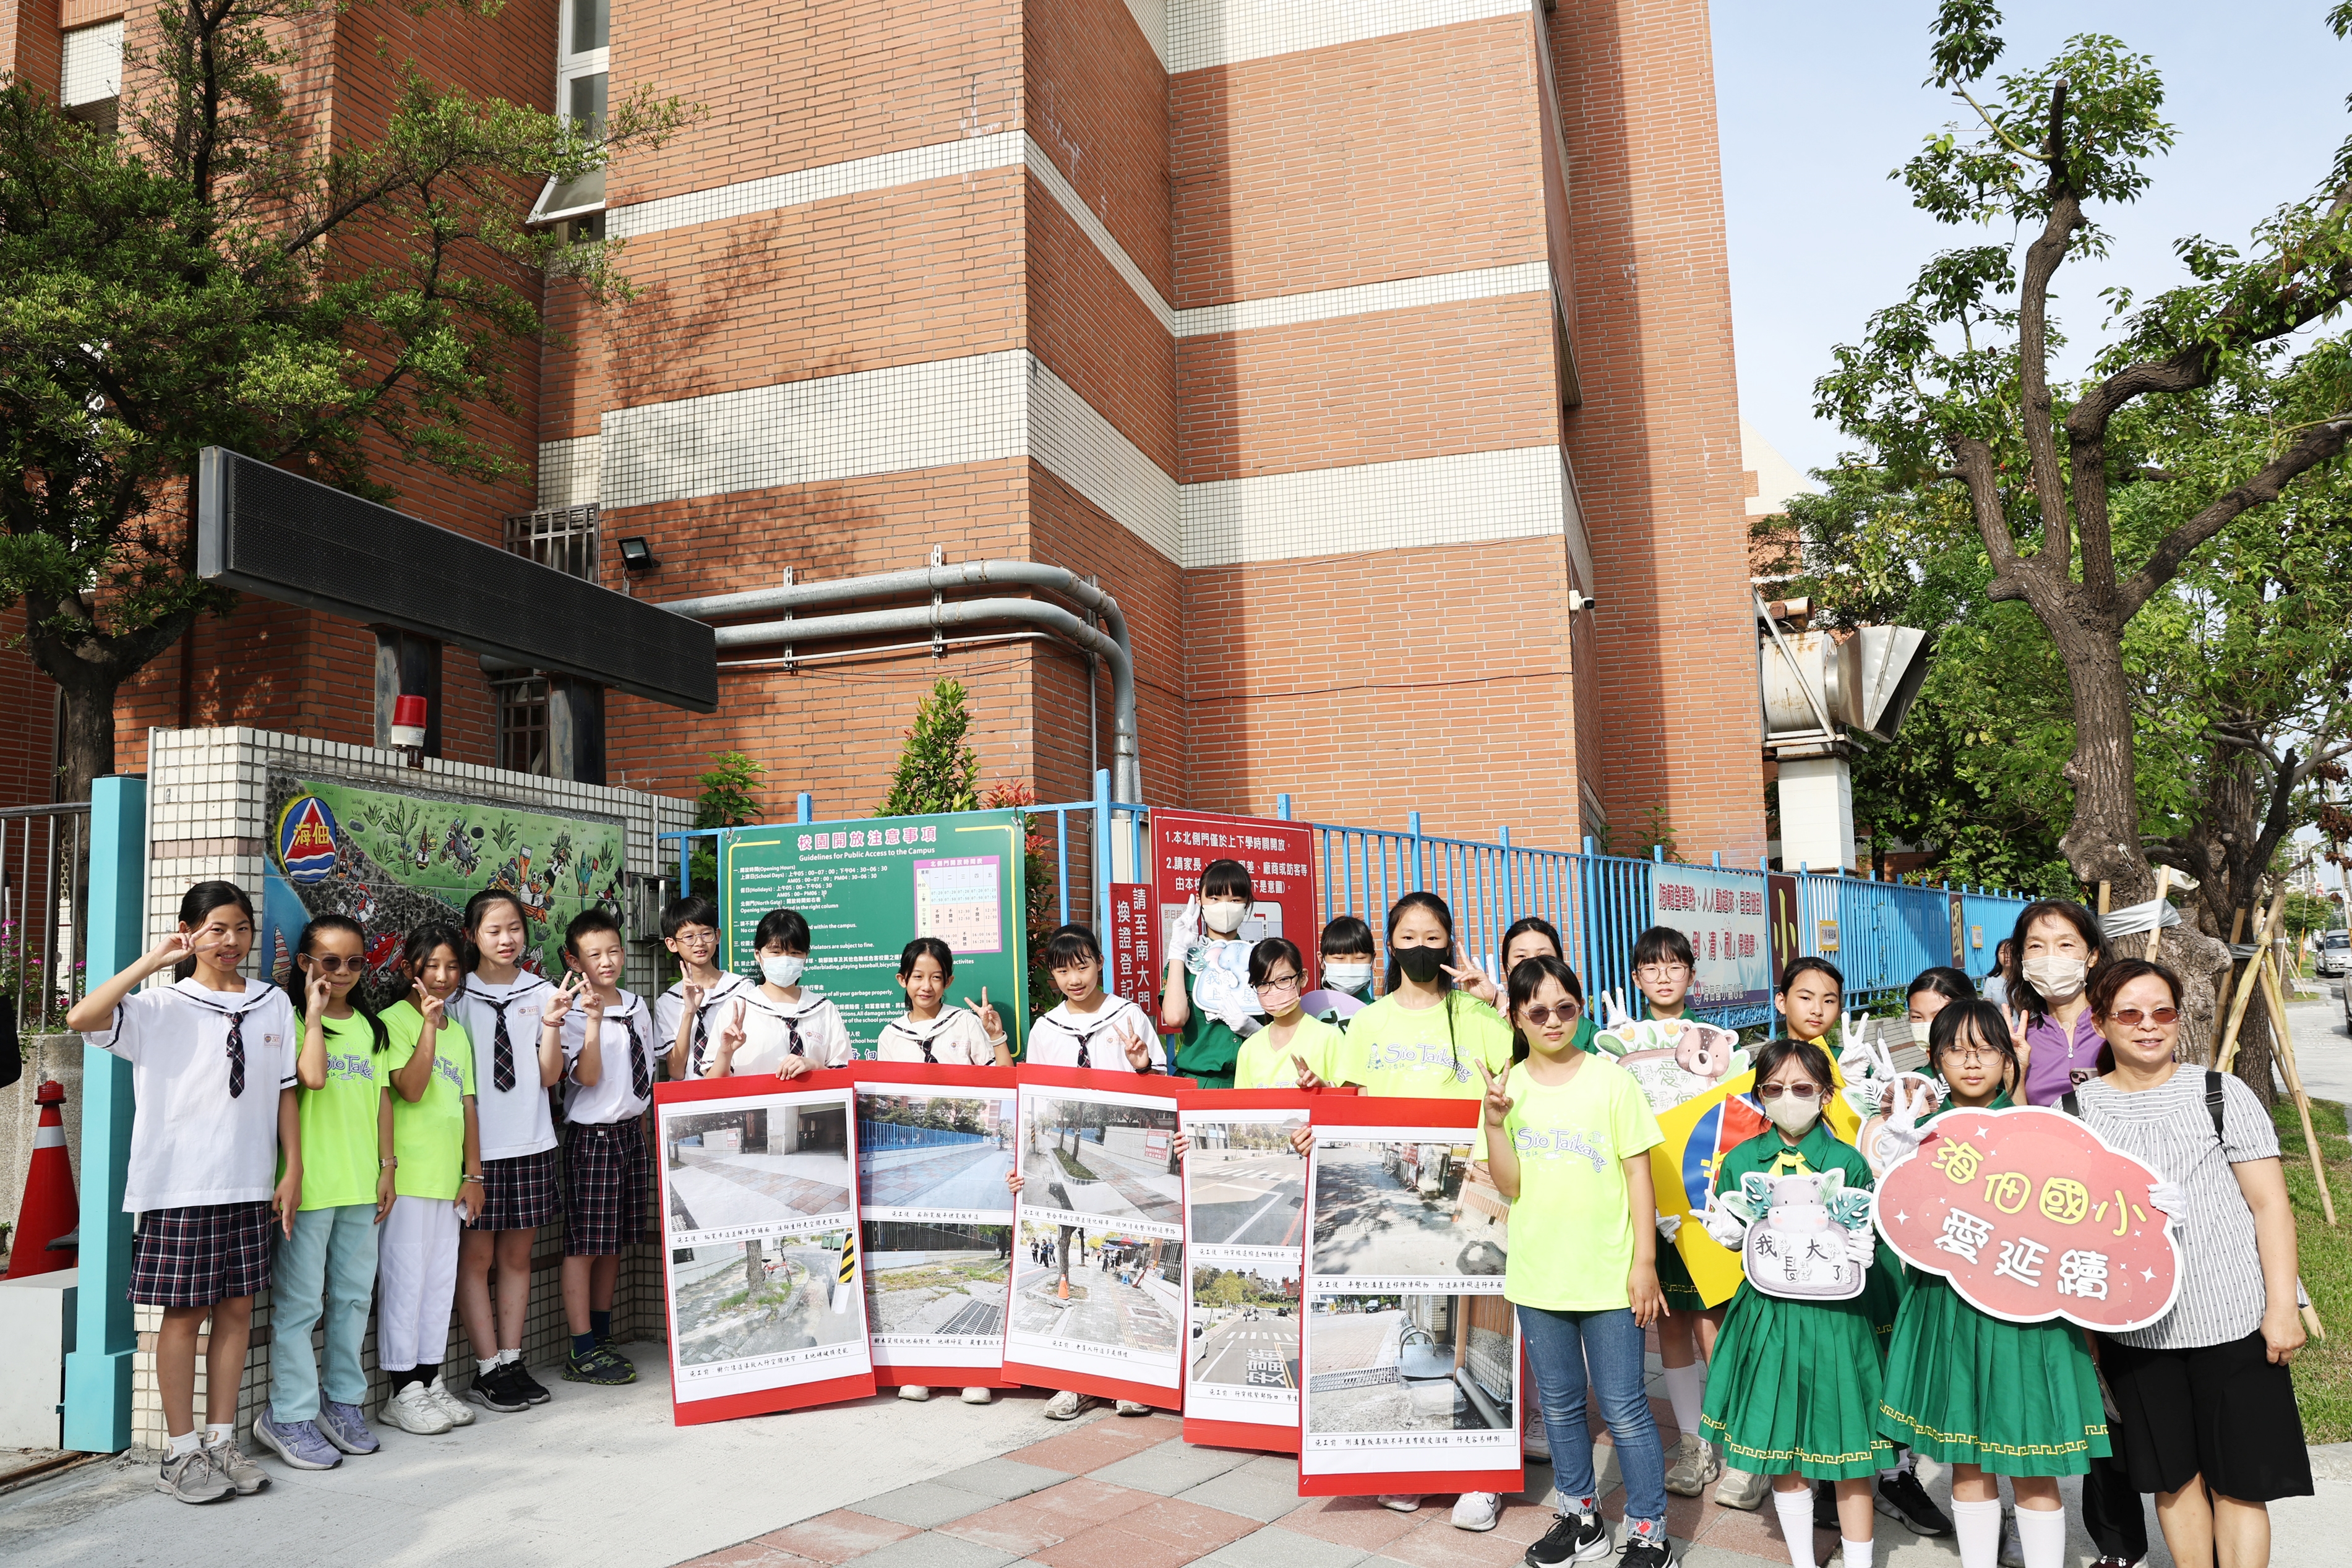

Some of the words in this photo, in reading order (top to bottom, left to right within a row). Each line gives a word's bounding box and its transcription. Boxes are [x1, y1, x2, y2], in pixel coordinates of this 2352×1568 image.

[293, 822, 330, 847] 海佃
[797, 825, 937, 851] 校園開放注意事項
[799, 853, 832, 862] Guidelines
[908, 846, 935, 855] Campus
[930, 858, 983, 867] 北側門開放時間表
[1117, 900, 1134, 1001] 換證登記
[1132, 887, 1151, 1013] 請至南大門
[1774, 888, 1796, 971] 小
[1384, 1043, 1417, 1063] Sio
[1416, 1043, 1473, 1083] Taikang
[1657, 1061, 1681, 1088] 愛
[1515, 1127, 1550, 1150] Sio
[1548, 1128, 1607, 1173] Taikang
[1931, 1137, 2147, 1236] 海佃國小
[1934, 1207, 2109, 1301] 愛延續
